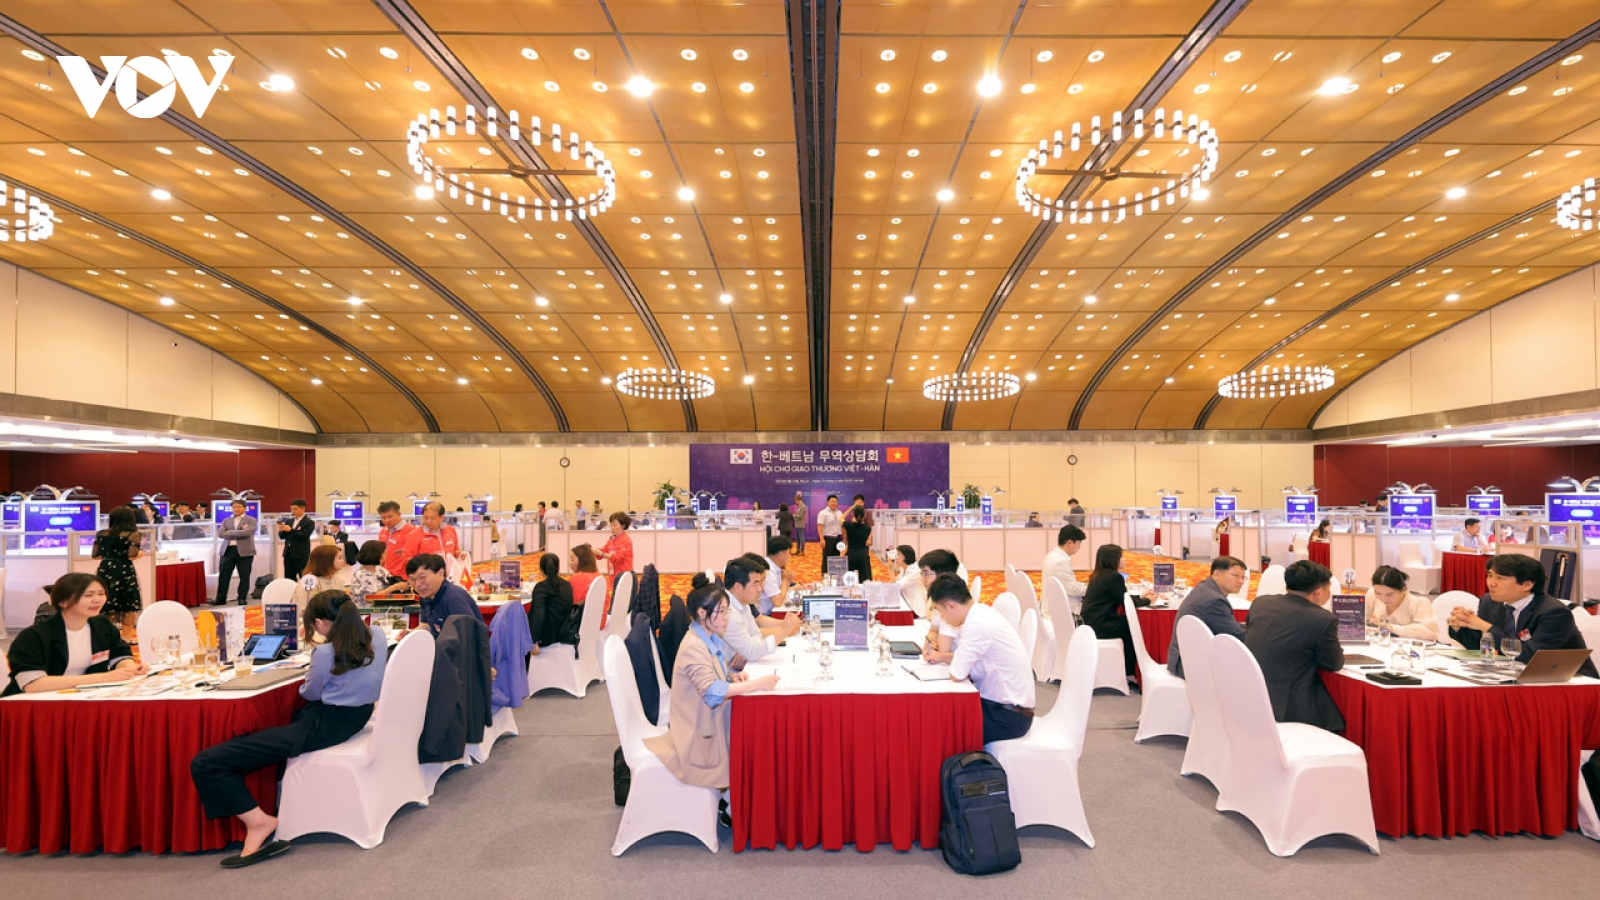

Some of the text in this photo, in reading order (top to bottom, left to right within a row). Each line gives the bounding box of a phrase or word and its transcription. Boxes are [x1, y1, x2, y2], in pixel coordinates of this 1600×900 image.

[761, 449, 879, 463] 한-베트남 무역상담회
[760, 464, 773, 474] HỘI
[774, 464, 791, 474] CHỢ
[811, 464, 843, 472] THƯƠNG
[304, 578, 315, 586] 45
[846, 575, 856, 585] 46
